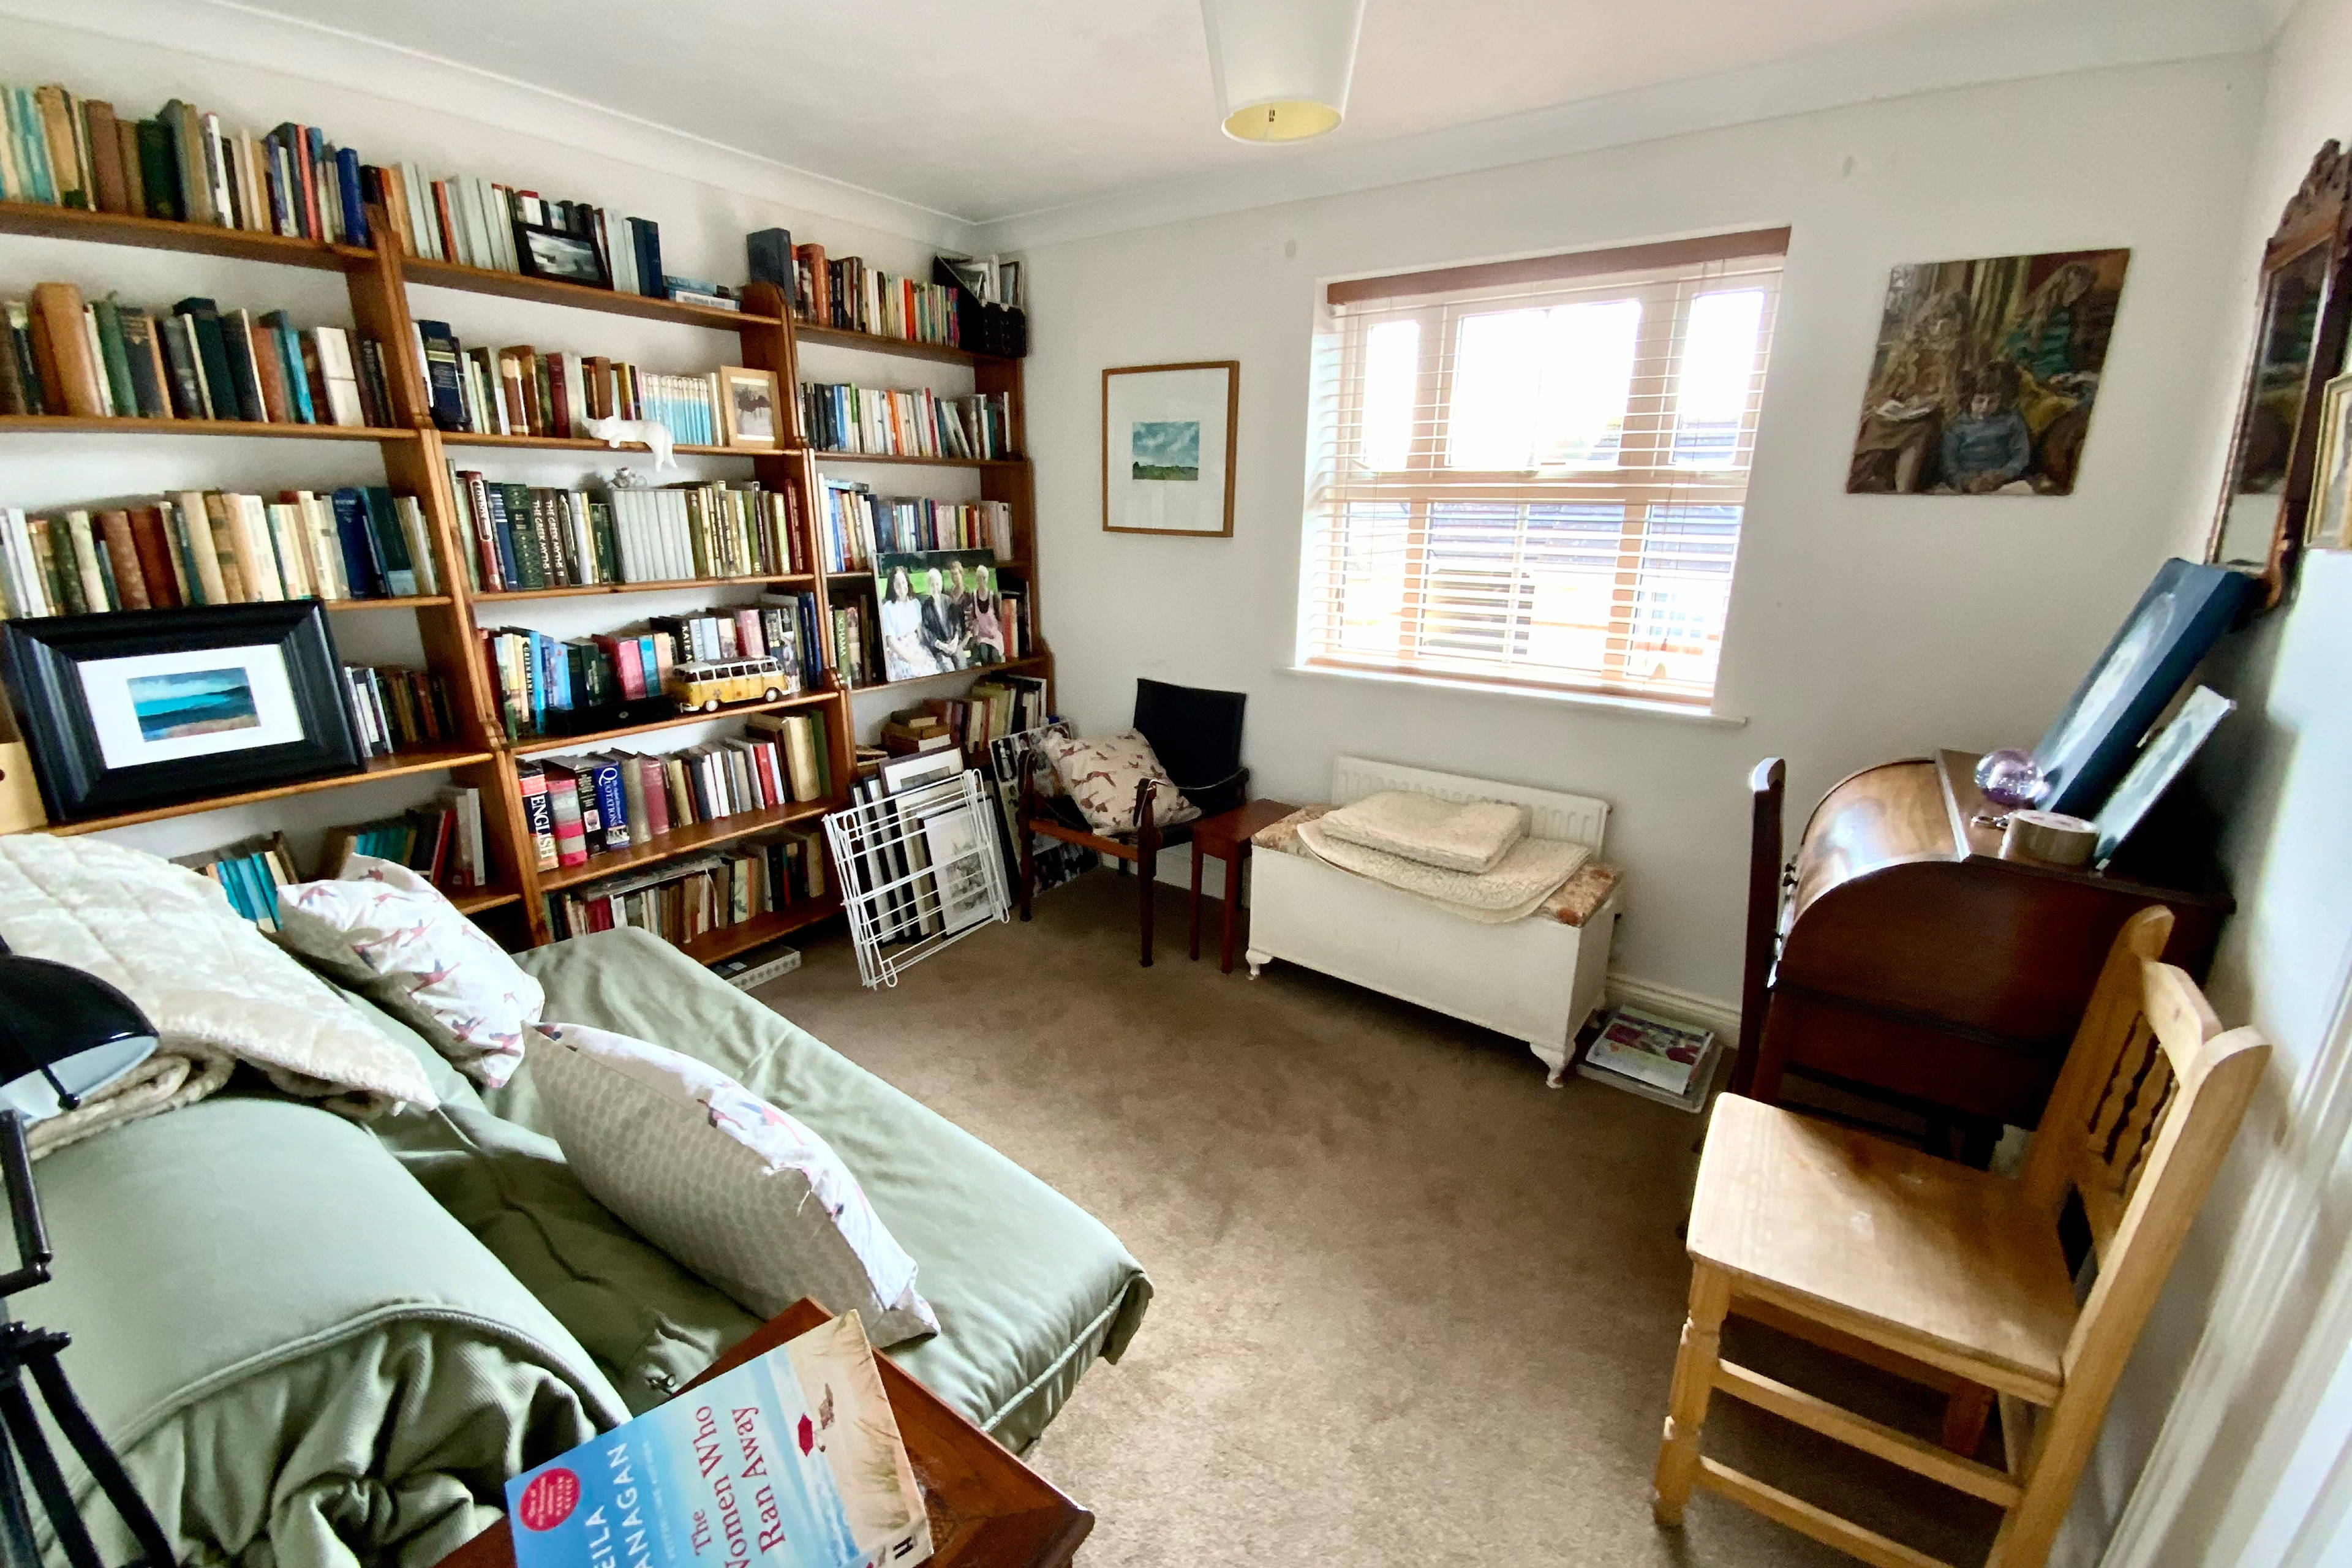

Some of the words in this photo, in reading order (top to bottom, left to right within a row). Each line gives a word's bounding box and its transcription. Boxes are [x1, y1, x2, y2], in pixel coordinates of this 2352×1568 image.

[532, 500, 542, 516] THE
[545, 500, 555, 516] THE
[535, 518, 546, 543] GREEK
[548, 517, 558, 542] GREEK
[539, 542, 550, 569] MYTHS
[552, 541, 564, 568] MYTHS
[837, 617, 847, 657] SCHAMA
[598, 767, 618, 827] QUOTATIONS
[530, 795, 555, 859] ENGLISH
[692, 1405, 724, 1479] Who
[731, 1407, 767, 1478] Away
[691, 1509, 712, 1556] The
[755, 1482, 786, 1556] Ran
